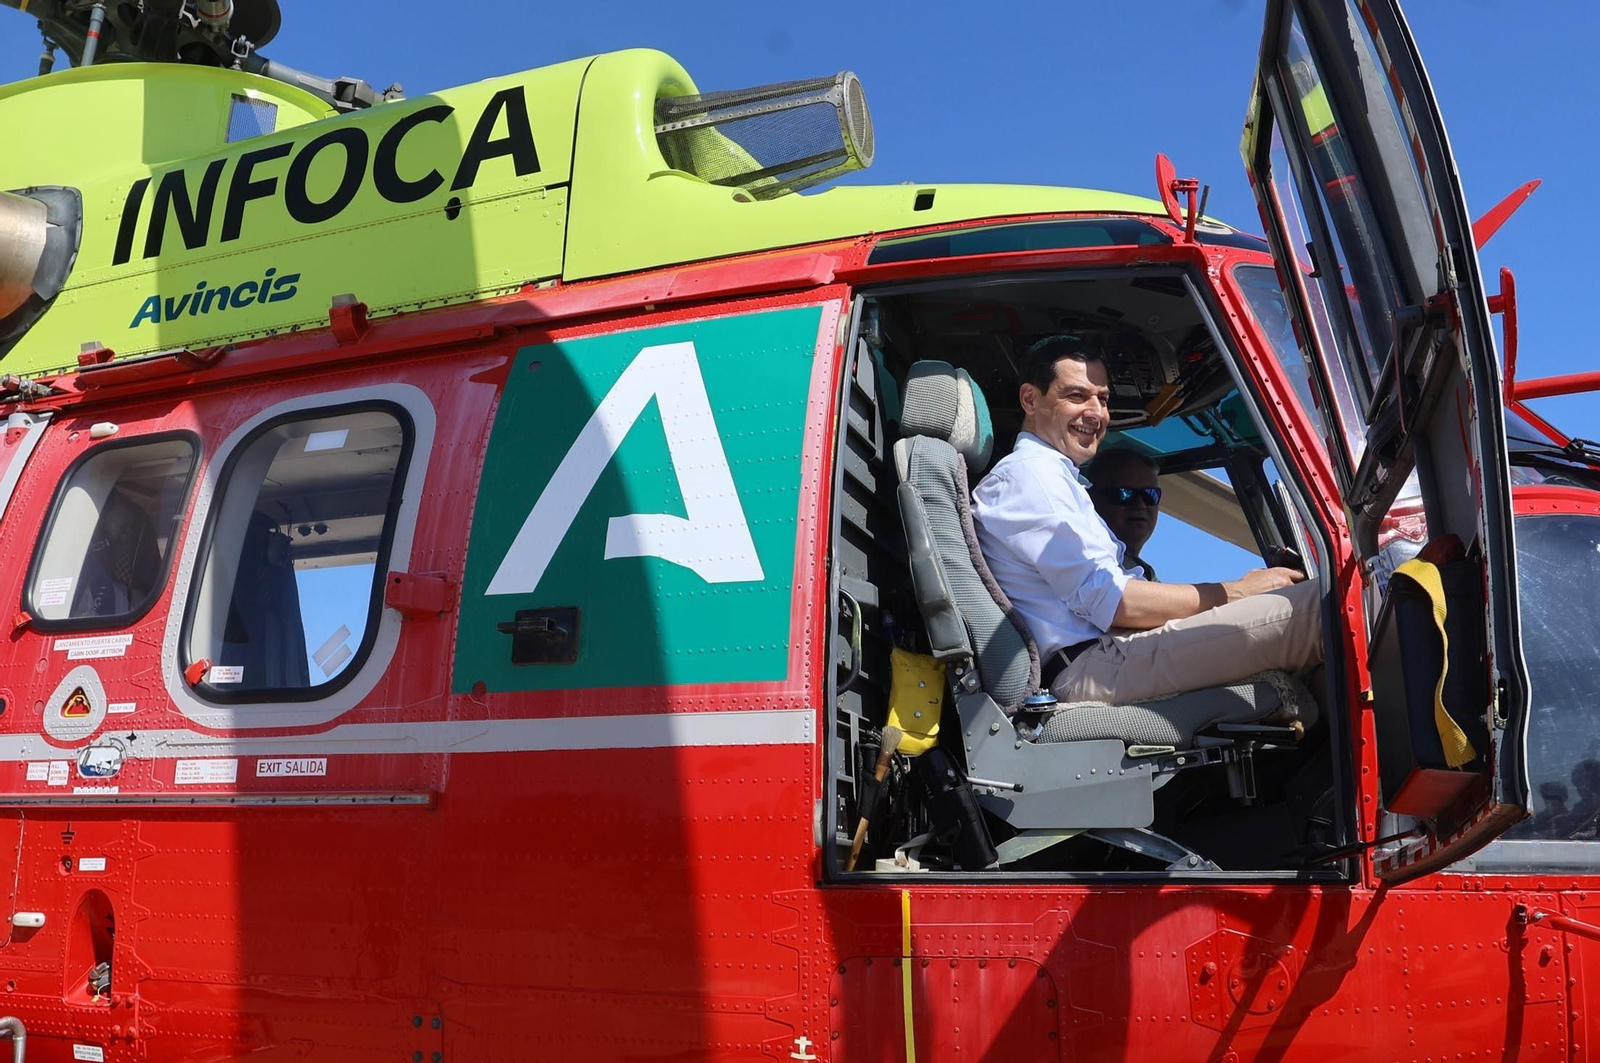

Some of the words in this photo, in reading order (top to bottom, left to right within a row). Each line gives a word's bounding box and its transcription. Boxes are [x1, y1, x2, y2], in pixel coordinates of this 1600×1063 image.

[112, 86, 541, 266] INFOCA
[128, 267, 300, 329] Avincis
[56, 640, 91, 648] LANZAMIENTO
[111, 636, 131, 644] CABINA
[259, 762, 282, 773] EXIT
[285, 761, 324, 773] SALIDA
